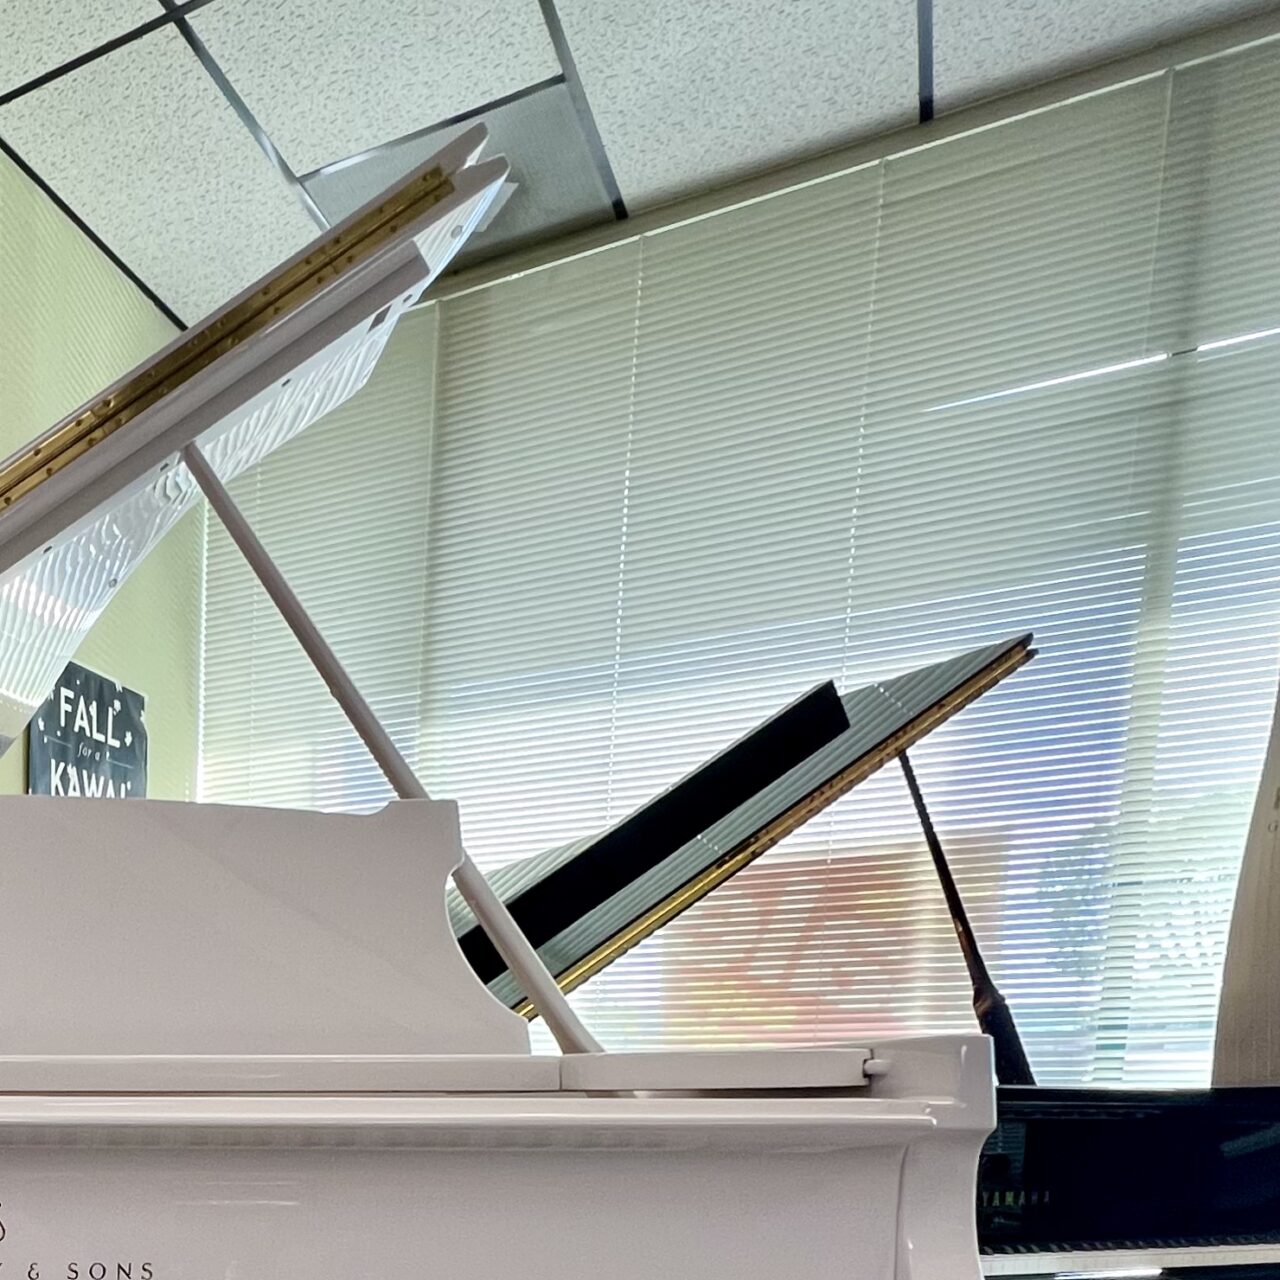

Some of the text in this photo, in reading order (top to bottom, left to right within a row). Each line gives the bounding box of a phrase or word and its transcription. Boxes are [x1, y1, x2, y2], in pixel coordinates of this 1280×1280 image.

[60, 686, 120, 748] FALL
[77, 742, 91, 758] for
[982, 1190, 1050, 1207] YAMAHA
[27, 1262, 39, 1280] &
[67, 1262, 153, 1280] SONS
